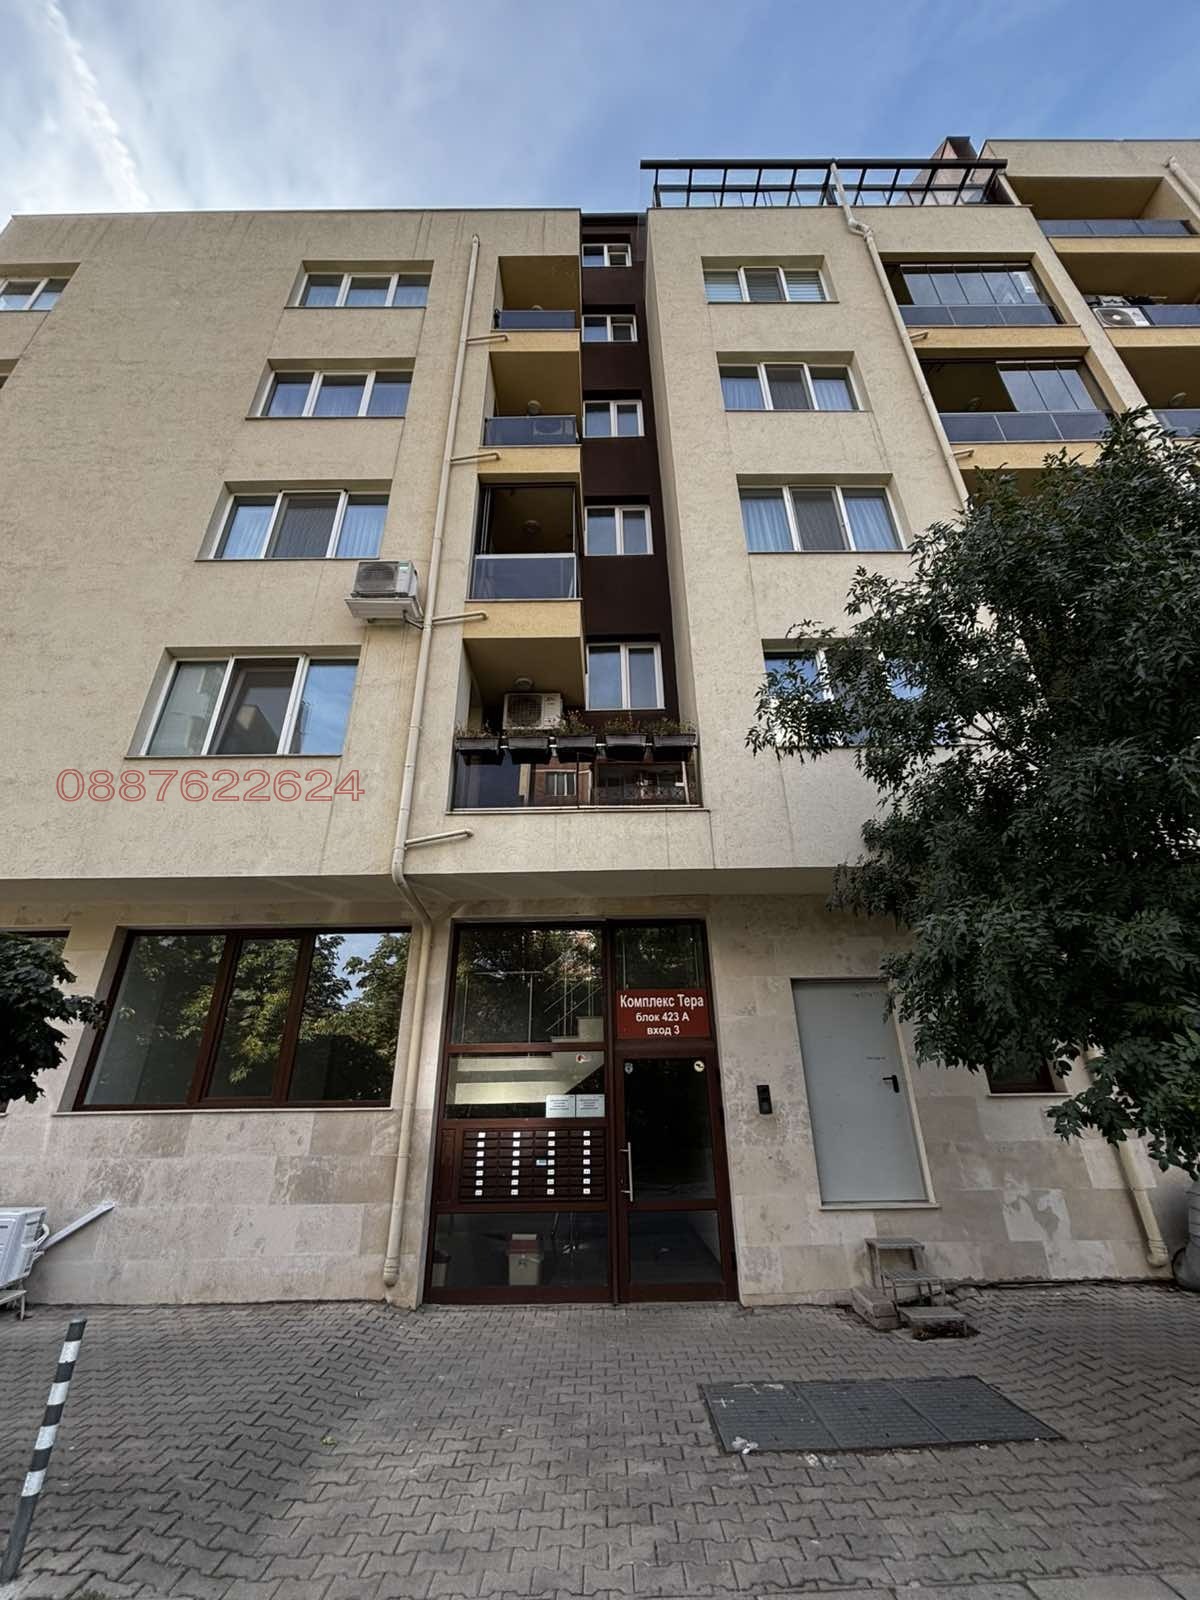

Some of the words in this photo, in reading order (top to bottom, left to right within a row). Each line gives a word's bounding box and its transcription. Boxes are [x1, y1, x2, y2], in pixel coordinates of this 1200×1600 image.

[620, 994, 675, 1008] Комплекс
[677, 993, 704, 1010] Тера
[636, 1012, 660, 1022] блок
[662, 1012, 680, 1021] 423
[647, 1026, 672, 1036] вход
[673, 1025, 680, 1035] 3
